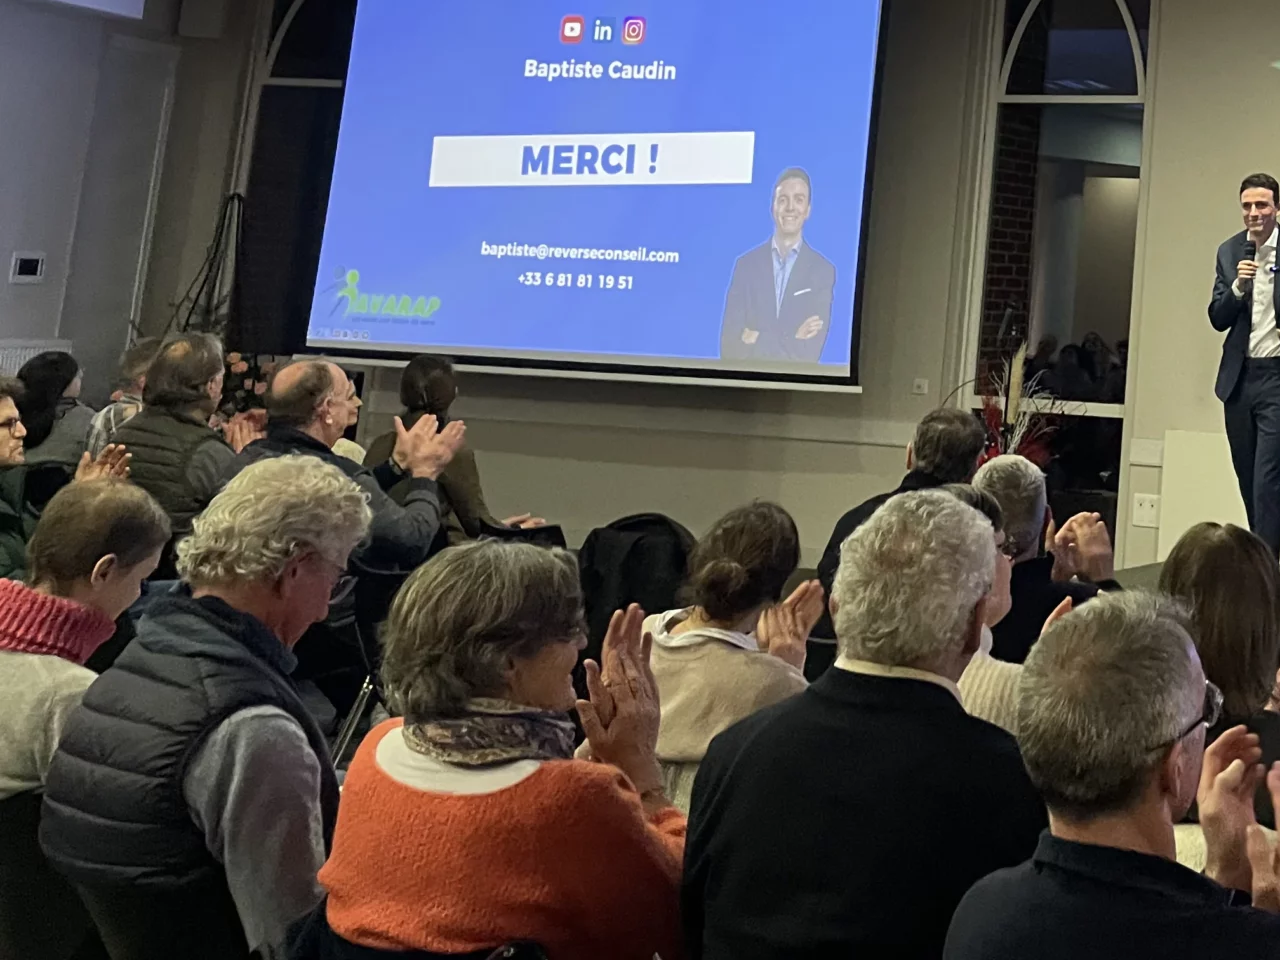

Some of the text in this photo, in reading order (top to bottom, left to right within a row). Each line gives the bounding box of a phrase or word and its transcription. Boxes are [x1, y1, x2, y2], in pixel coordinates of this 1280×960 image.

[524, 58, 676, 82] Baptiste Caudin
[521, 144, 659, 175] MERCI !
[481, 241, 679, 262] baptiste@reverseconseil.com
[518, 272, 633, 289] +33 6 81 81 19 51
[354, 294, 441, 317] AVARAP
